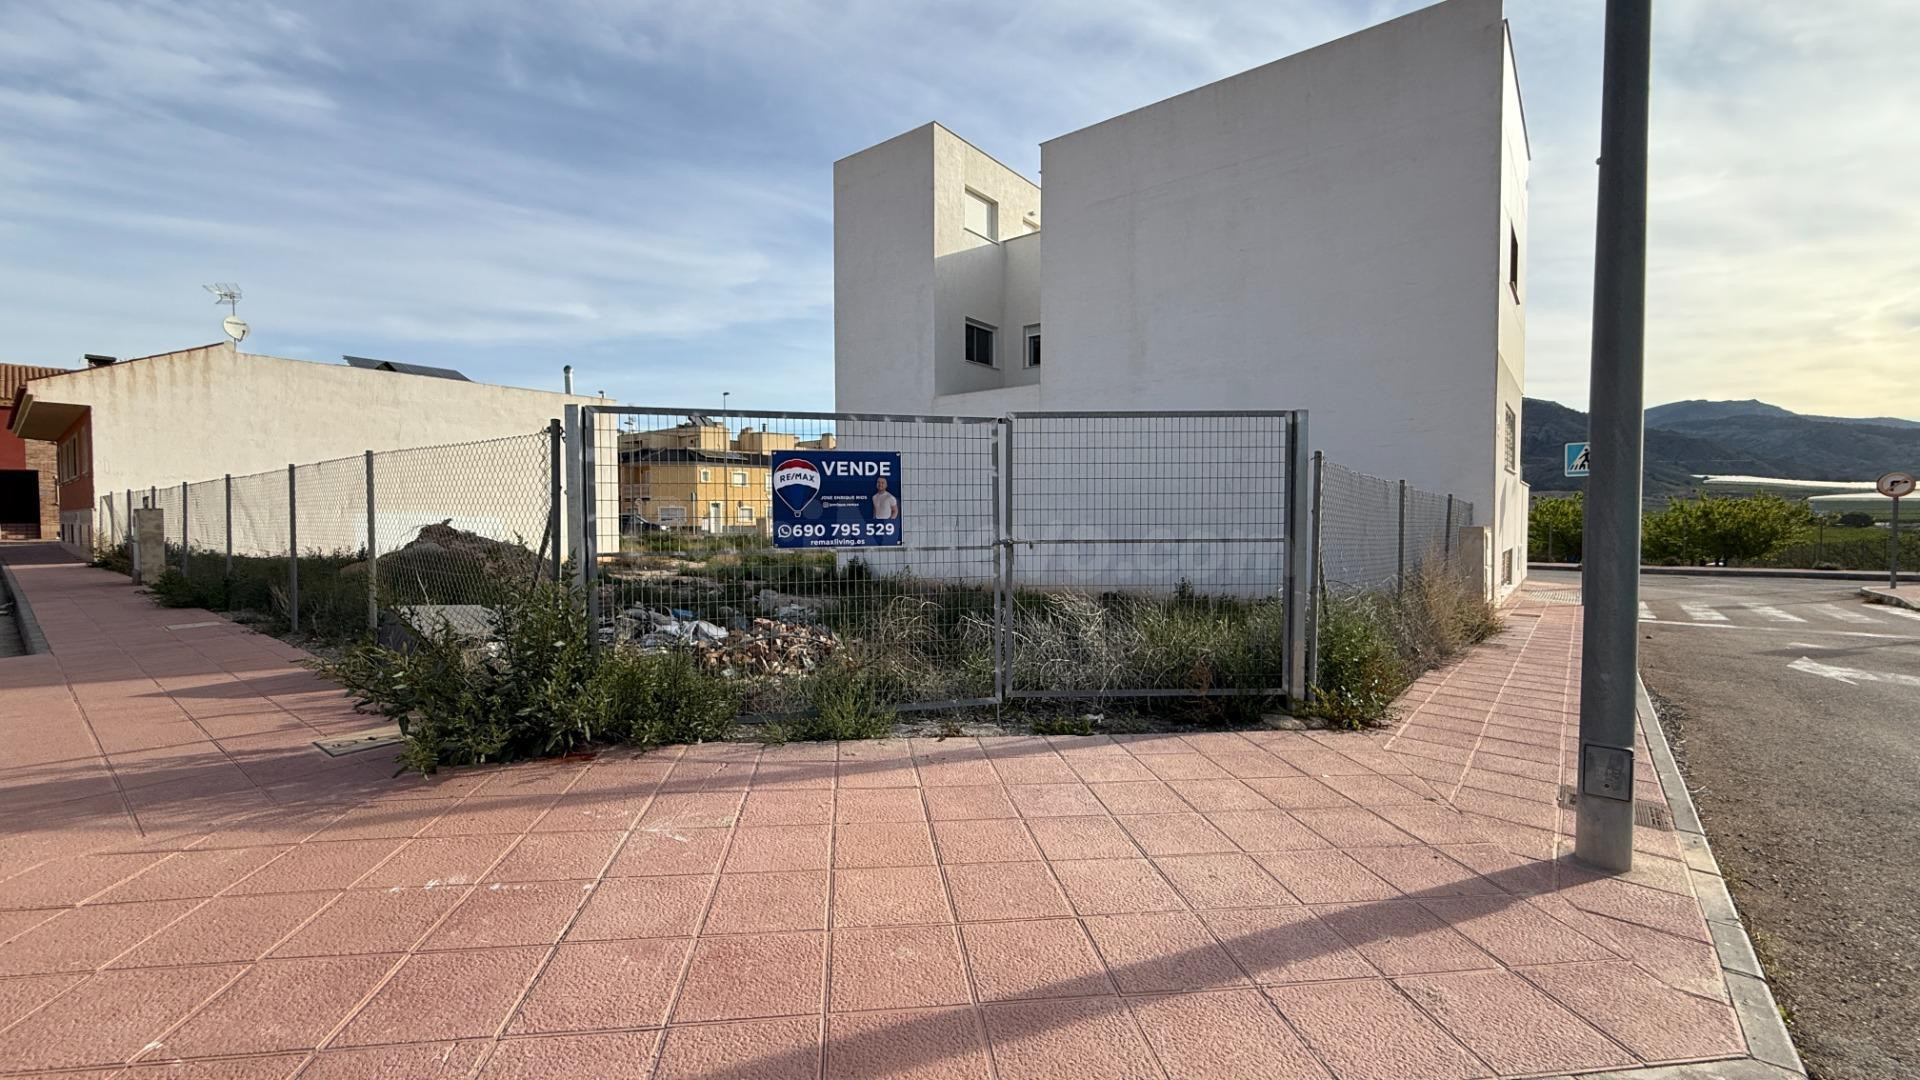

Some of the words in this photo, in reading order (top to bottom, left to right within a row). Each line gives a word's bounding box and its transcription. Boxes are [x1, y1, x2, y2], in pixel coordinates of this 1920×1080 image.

[822, 461, 891, 476] VENDE
[780, 472, 815, 483] RE/MAX
[792, 524, 826, 537] 690
[831, 524, 861, 537] 795
[866, 523, 895, 536] 529
